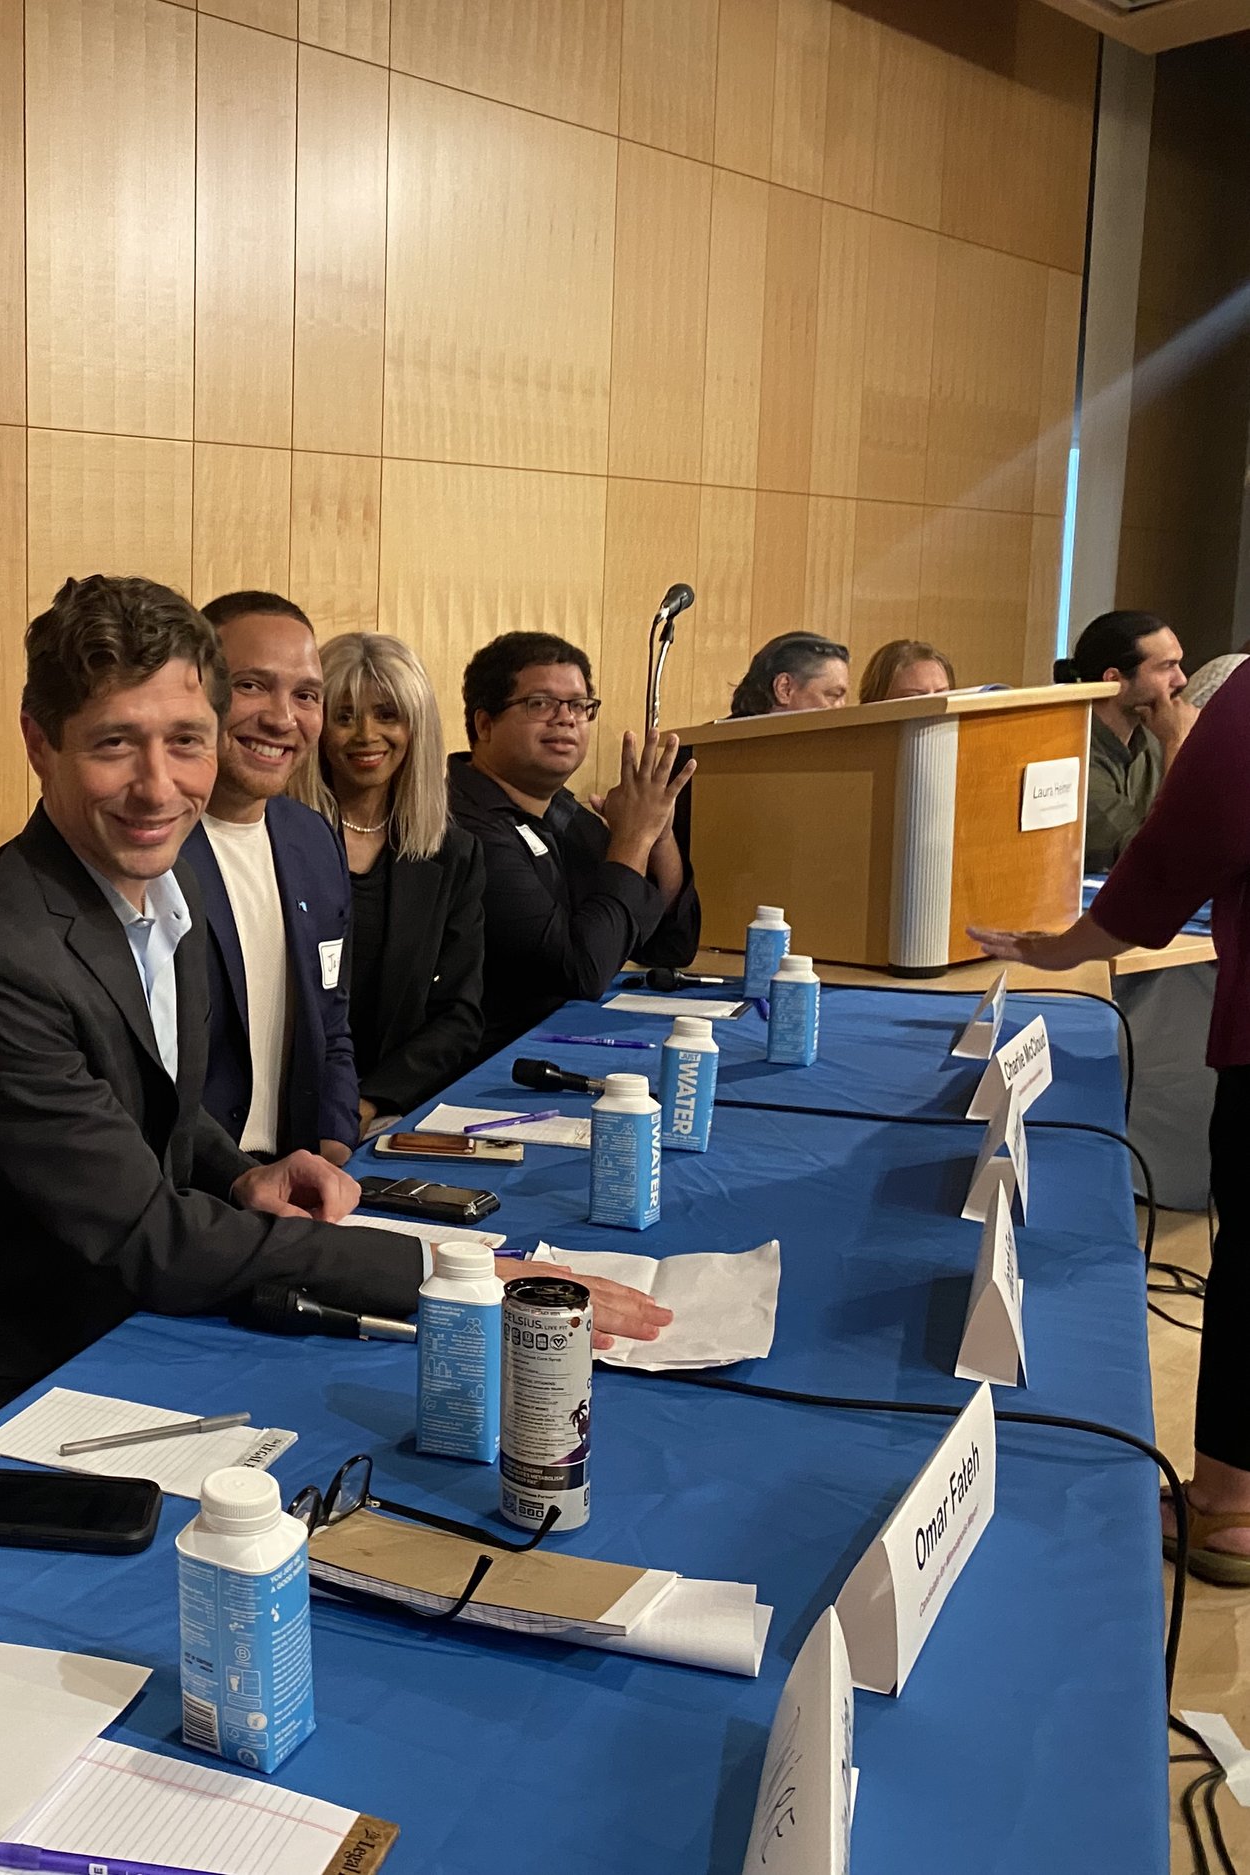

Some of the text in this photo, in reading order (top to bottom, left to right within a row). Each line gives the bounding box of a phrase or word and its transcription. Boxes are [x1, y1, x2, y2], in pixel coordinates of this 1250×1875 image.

[672, 1062, 700, 1135] WATER
[649, 1122, 662, 1209] WATER
[504, 1309, 542, 1329] CELSIUS
[915, 1441, 980, 1571] Omar Fateh
[342, 1840, 376, 1874] Legal
